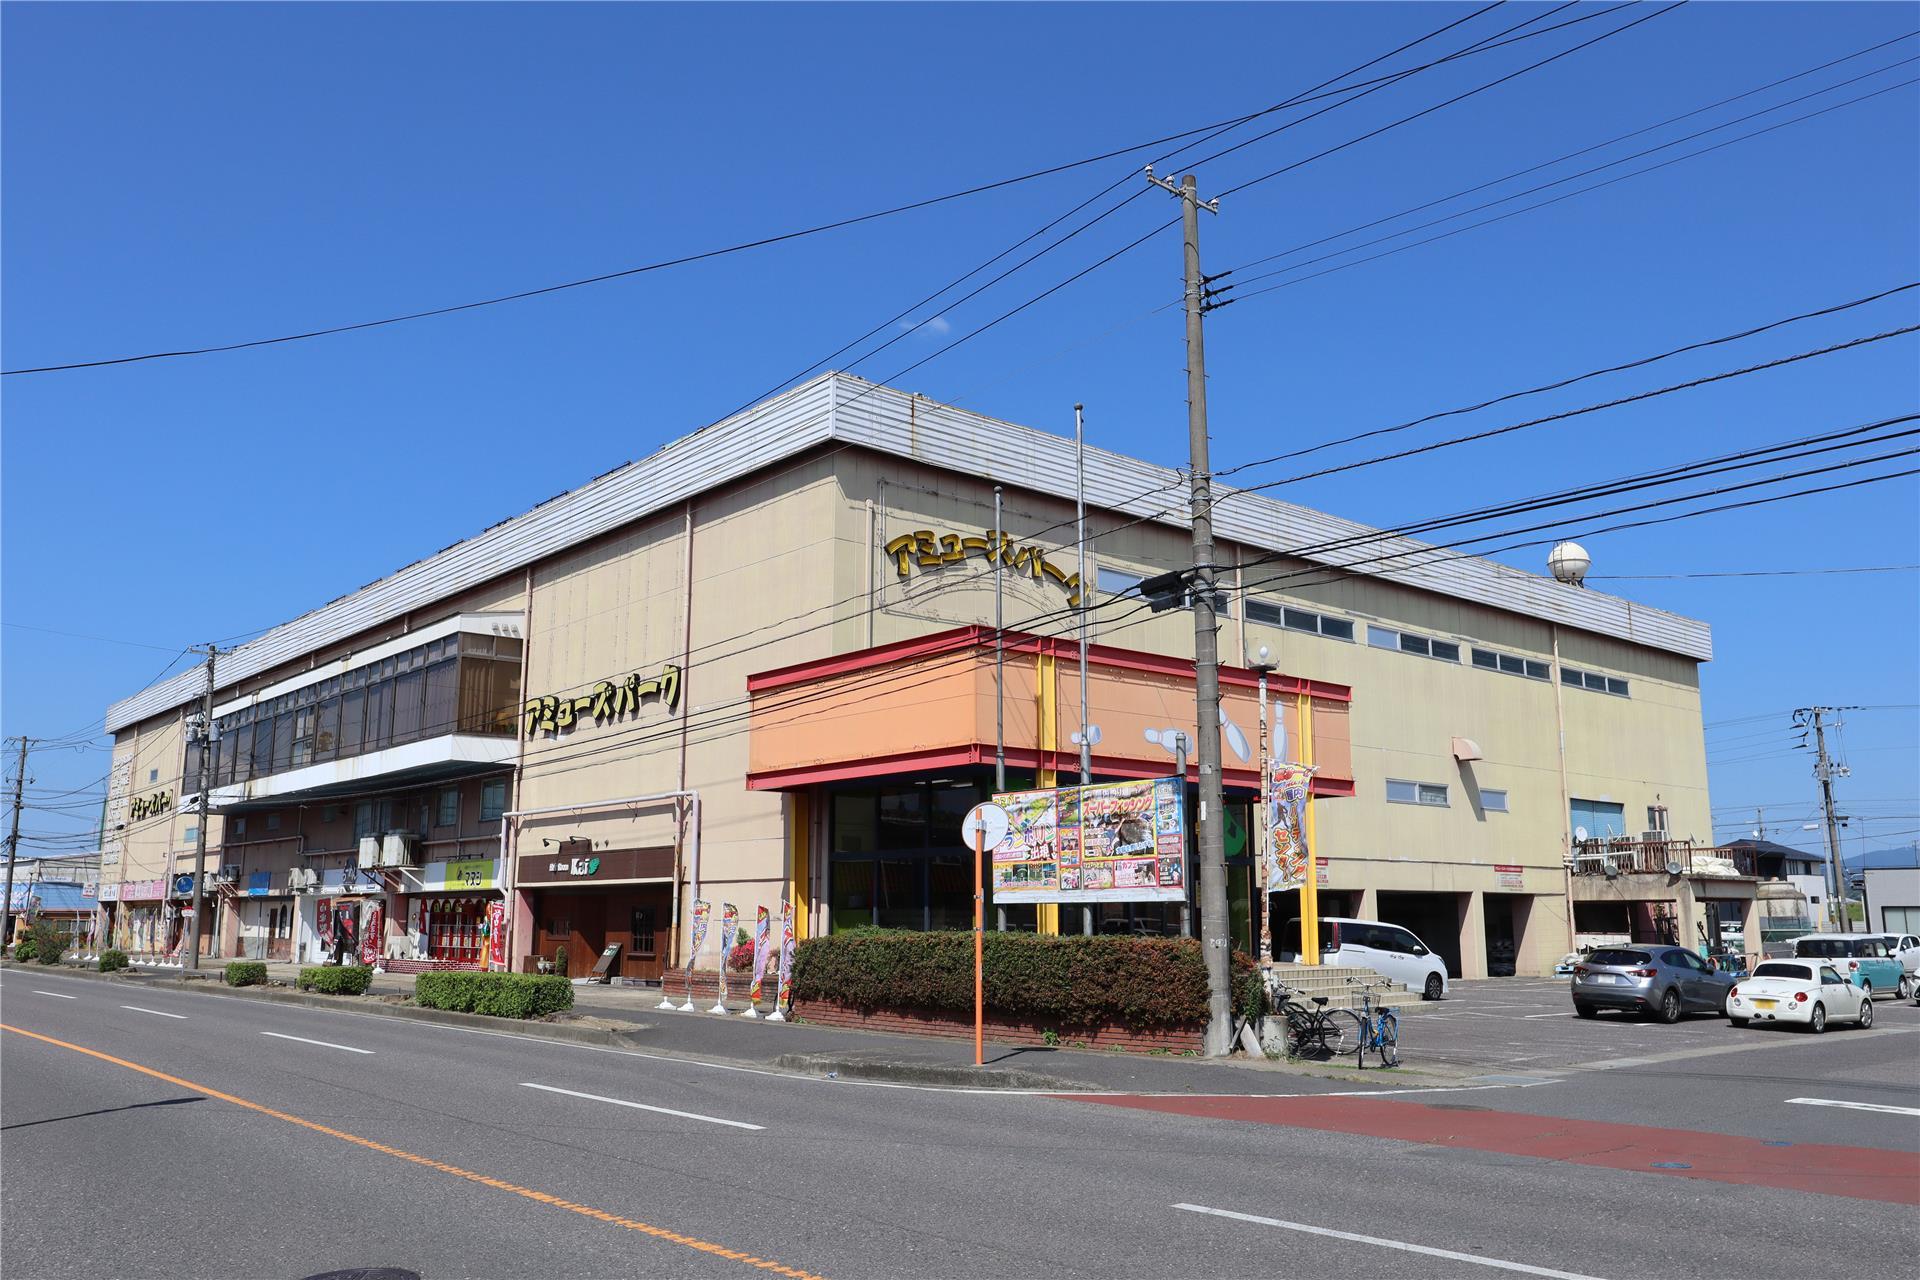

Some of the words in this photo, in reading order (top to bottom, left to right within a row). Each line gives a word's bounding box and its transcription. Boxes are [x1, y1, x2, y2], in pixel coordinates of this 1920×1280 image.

[525, 664, 682, 734] アミューズパーク
[1273, 828, 1291, 882] センター
